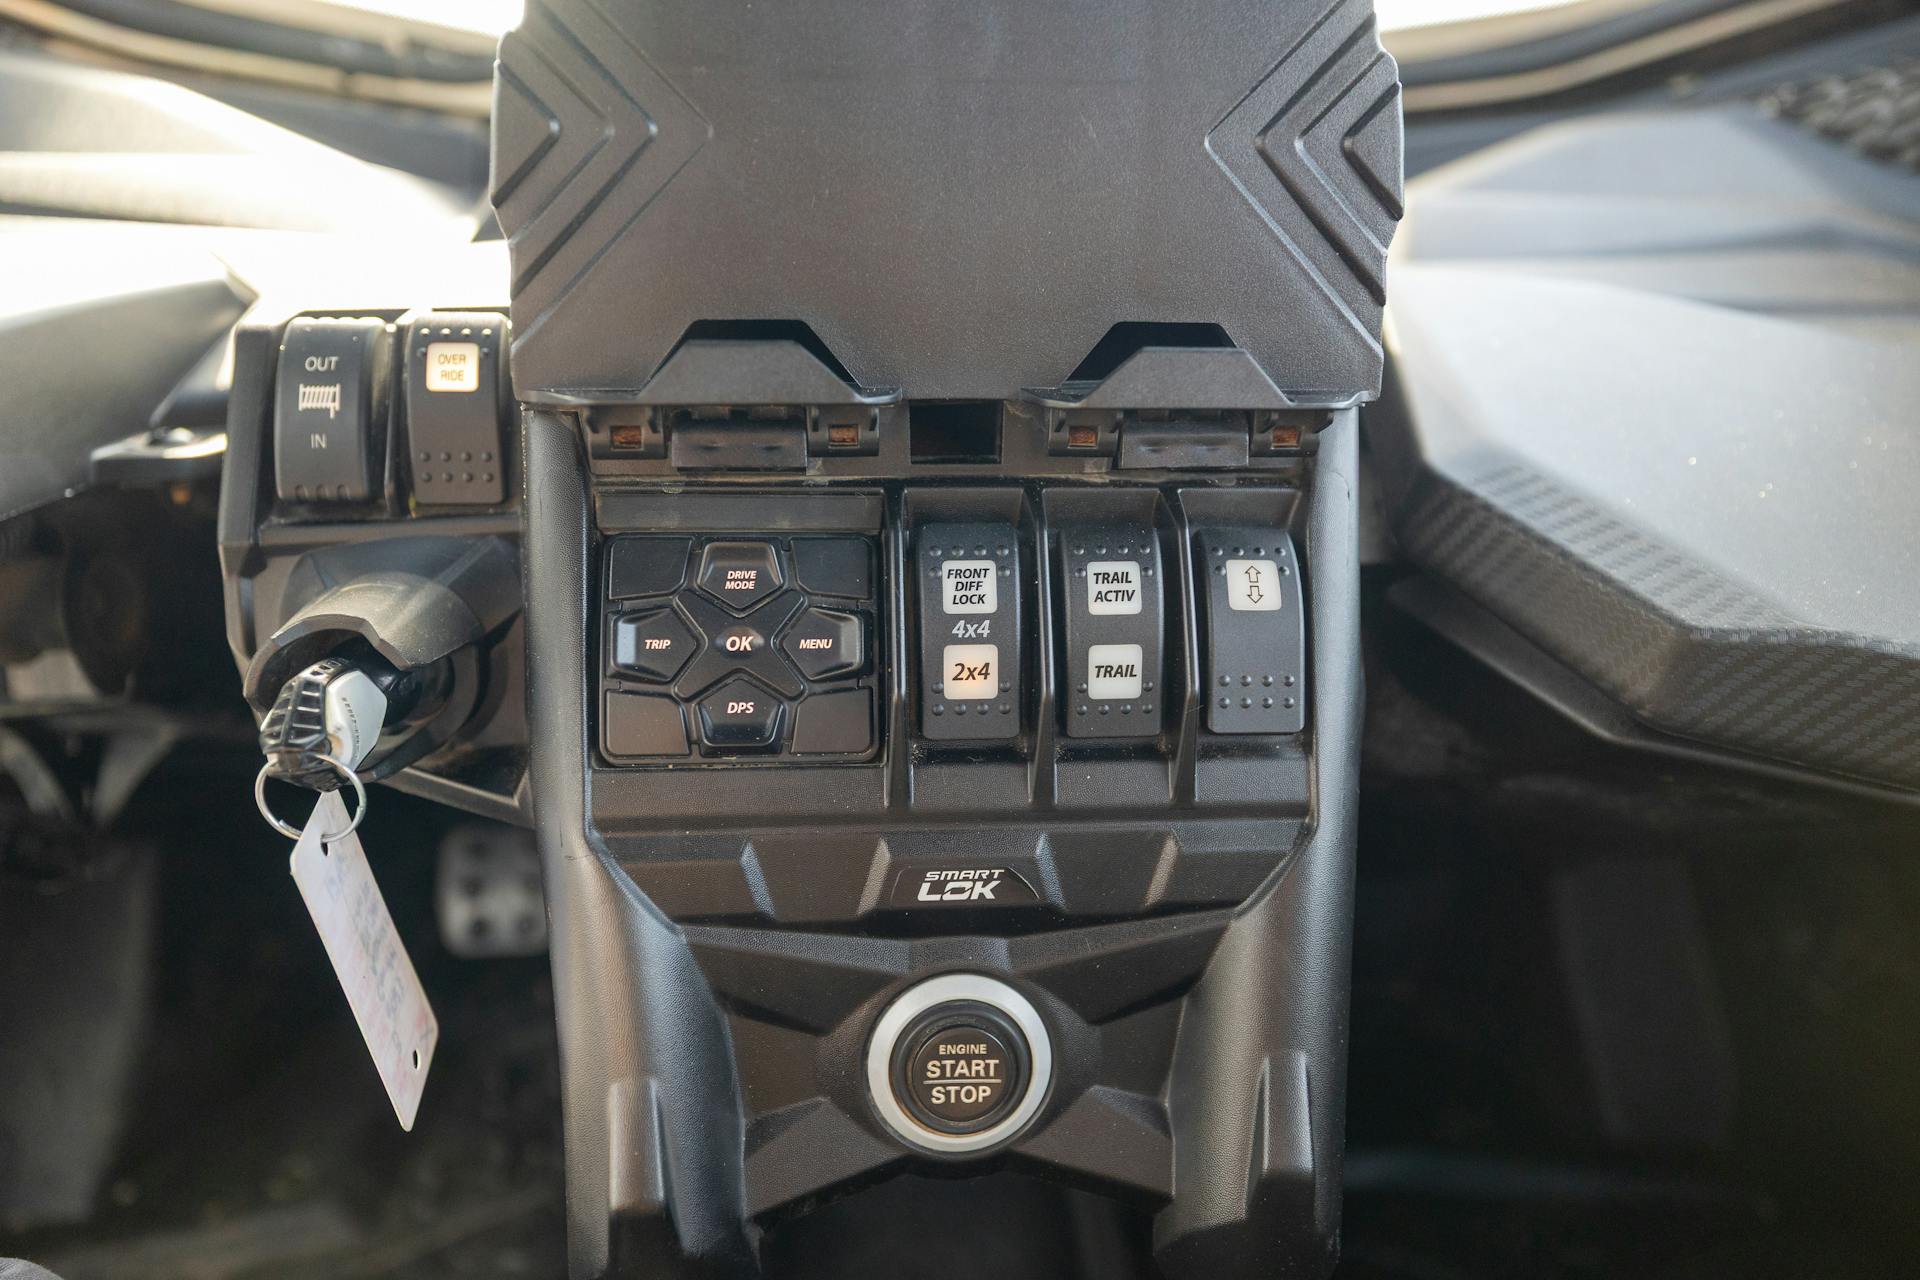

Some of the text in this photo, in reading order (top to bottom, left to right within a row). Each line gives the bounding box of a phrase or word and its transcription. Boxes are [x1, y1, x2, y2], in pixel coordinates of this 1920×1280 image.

[305, 356, 339, 371] OUT
[438, 353, 466, 365] OVER
[440, 369, 464, 381] RIDE
[311, 433, 326, 448] IN
[727, 570, 757, 580] DRIVE
[946, 568, 990, 580] FRONT
[1093, 571, 1133, 585] TRAIL
[725, 580, 755, 590] MODE
[954, 581, 984, 592] DIFF
[952, 593, 986, 606] LOCK
[1093, 589, 1136, 603] ACTIV
[951, 619, 991, 638] 4x4
[644, 639, 671, 650] TRIP
[725, 636, 754, 652] OK
[799, 639, 833, 649] MENU
[951, 662, 991, 681] 2x4
[1094, 664, 1138, 679] TRAIL
[727, 702, 754, 714] DPS
[924, 869, 1005, 881] SMART
[917, 880, 1002, 901] LOK
[938, 1044, 988, 1055] ENGINE
[926, 1059, 1000, 1079] START
[930, 1085, 992, 1105] STOP
